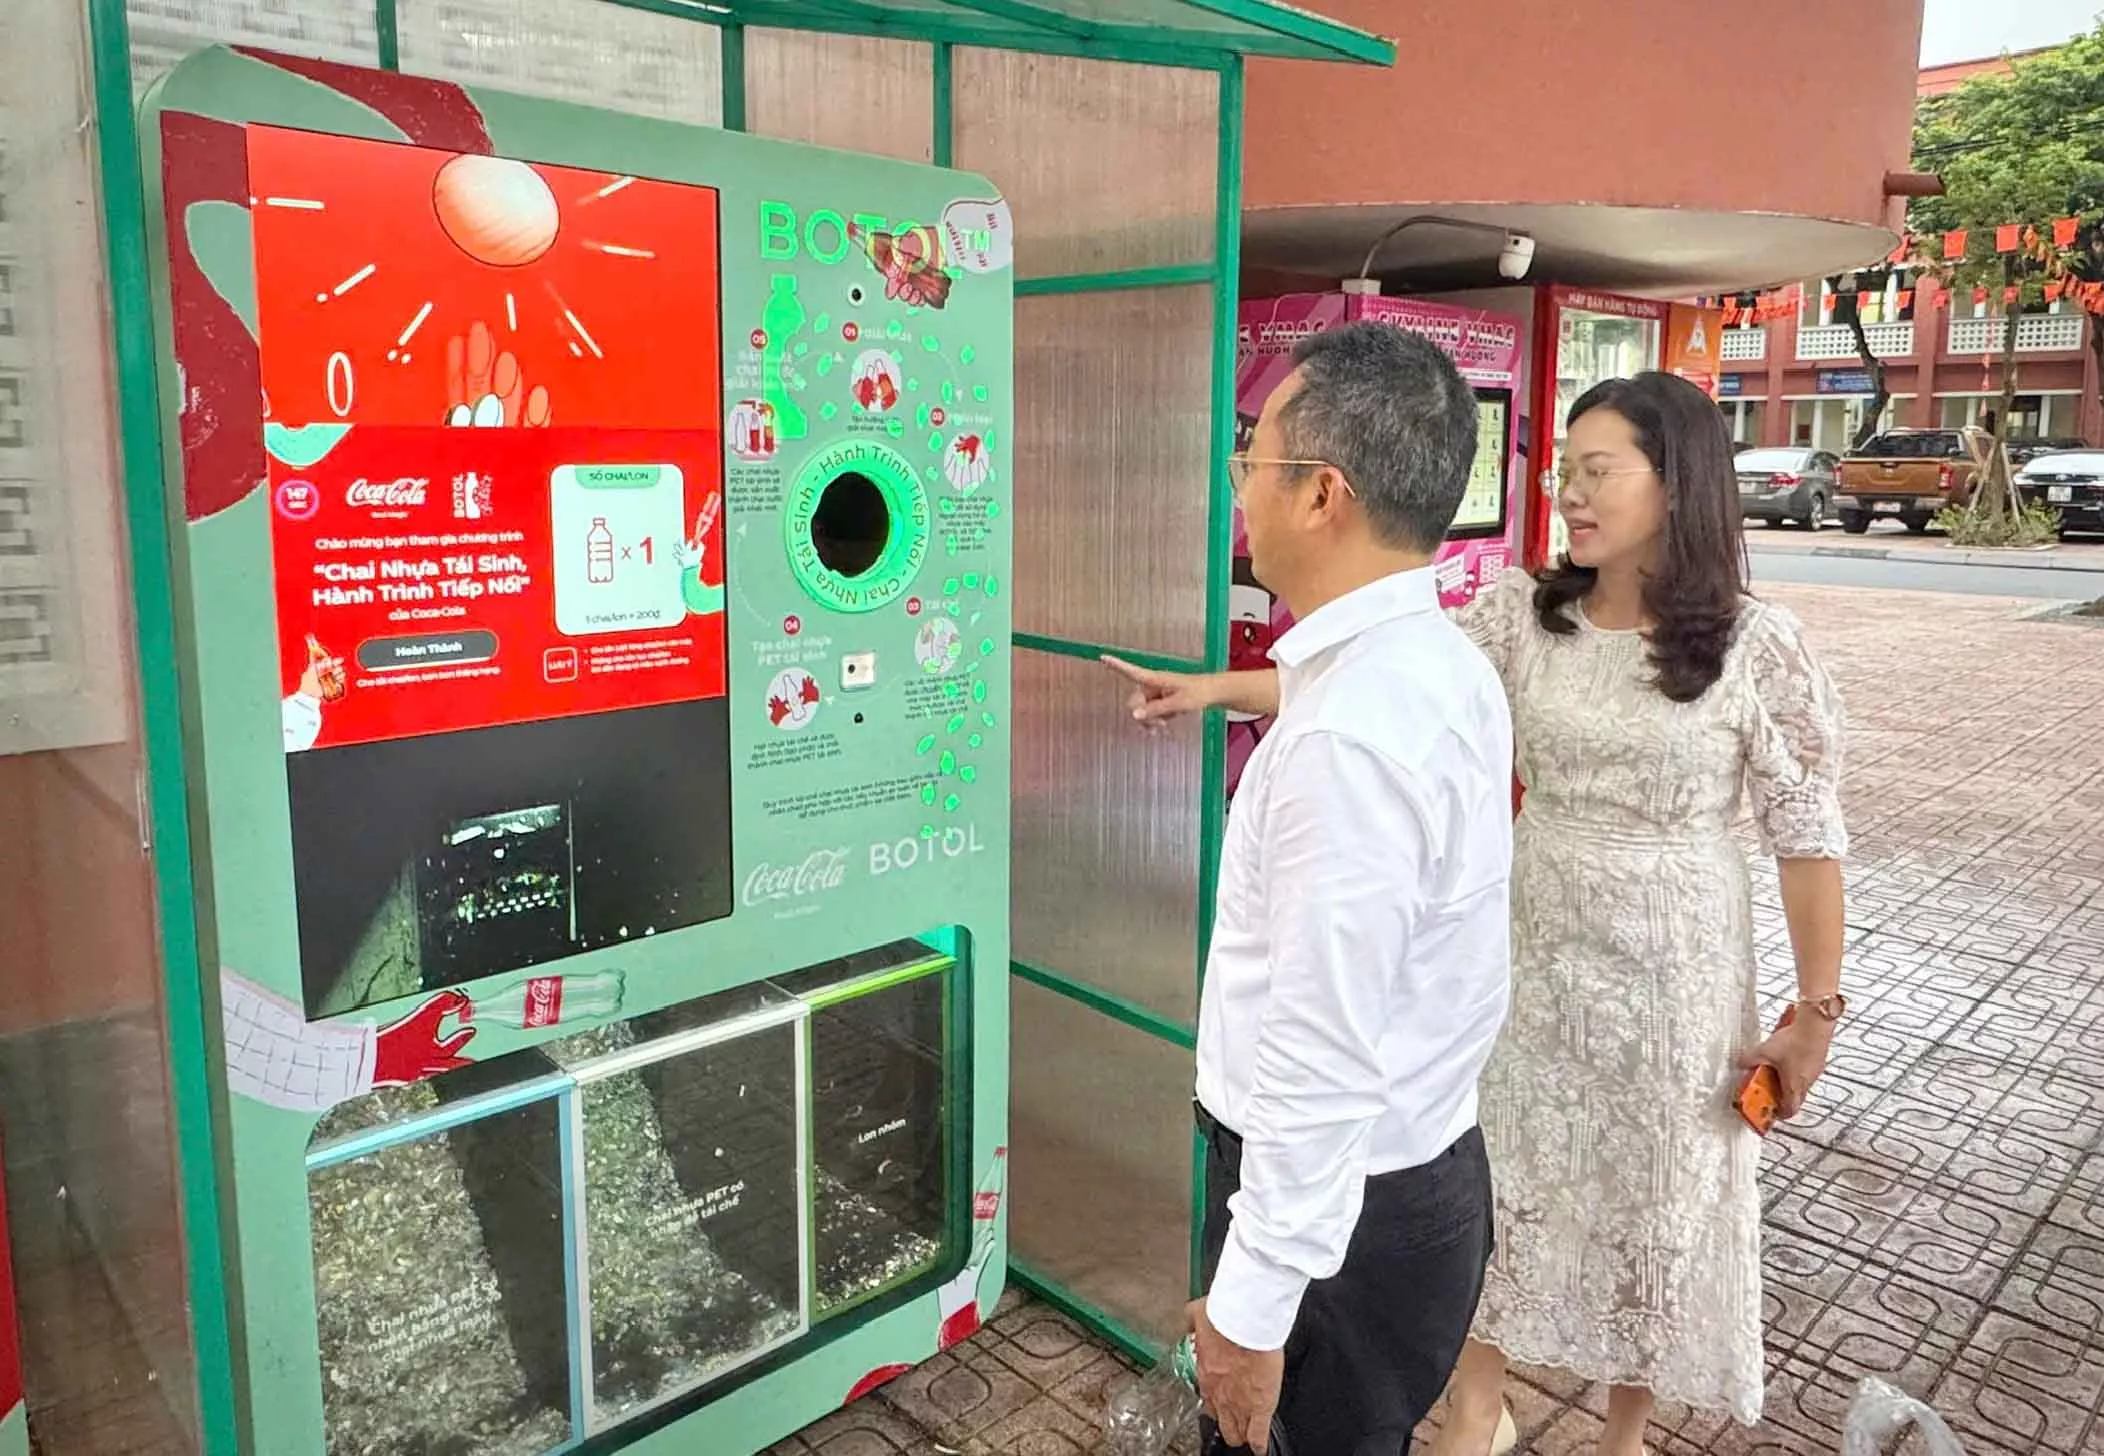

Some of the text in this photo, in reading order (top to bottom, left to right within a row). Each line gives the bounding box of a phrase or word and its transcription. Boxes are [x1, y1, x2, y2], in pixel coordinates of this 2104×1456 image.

[819, 444, 866, 475] Hành
[315, 531, 524, 550] Chào mừng bạn tham gia chương trình
[639, 536, 653, 565] 1
[380, 559, 441, 581] Nhựa
[442, 555, 474, 576] Tái
[477, 553, 528, 574] Sinh,
[312, 585, 374, 606] Hành
[377, 582, 435, 602] Trình
[437, 577, 484, 599] Tiếp
[388, 608, 411, 621] của
[394, 641, 463, 657] Hoàn Thành
[868, 822, 985, 876] BOTOL
[705, 1184, 730, 1204] PET
